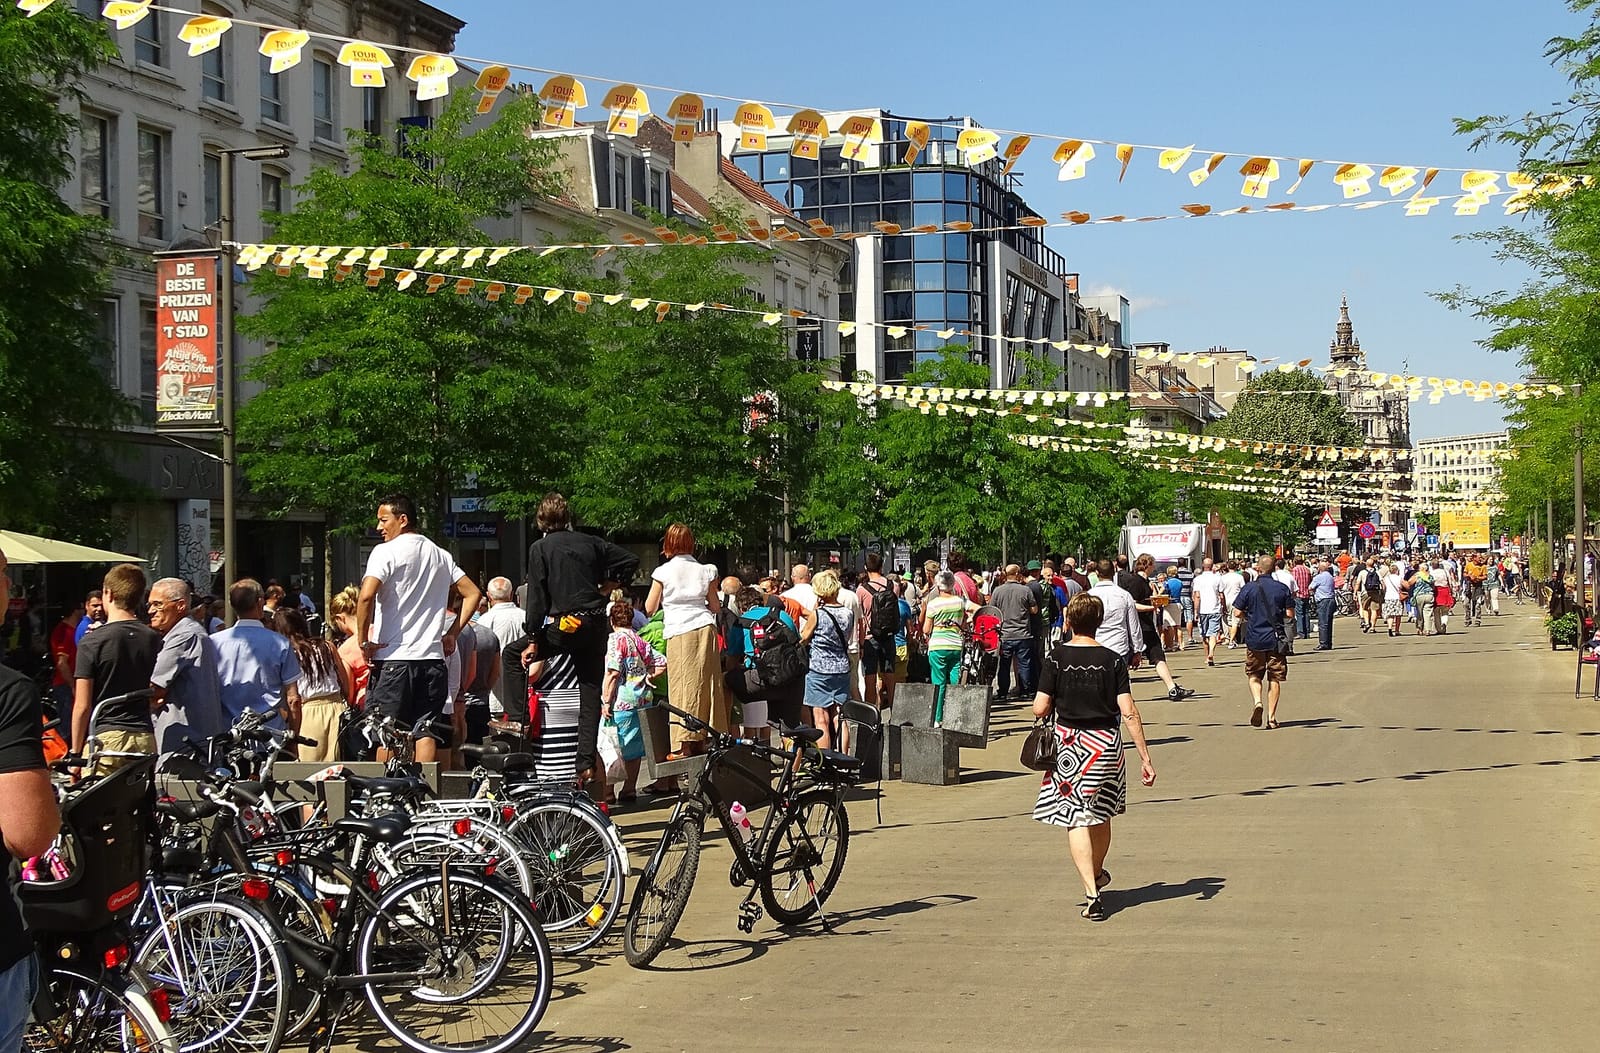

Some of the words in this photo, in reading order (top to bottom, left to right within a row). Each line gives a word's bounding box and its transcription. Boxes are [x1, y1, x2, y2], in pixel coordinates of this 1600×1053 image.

[352, 50, 377, 59] TOUR
[552, 85, 575, 97] TOUR
[615, 94, 638, 105] TOUR
[679, 103, 698, 113] TOUR
[743, 111, 763, 122] TOUR
[799, 119, 819, 130] TOUR
[852, 122, 872, 133] TOUR
[177, 263, 194, 276] DE
[166, 278, 206, 292] BESTE
[159, 293, 212, 308] PRIJZEN
[172, 309, 199, 323] VAN
[163, 326, 174, 339] 'T
[176, 325, 208, 338] STAD
[165, 349, 190, 360] Altijd
